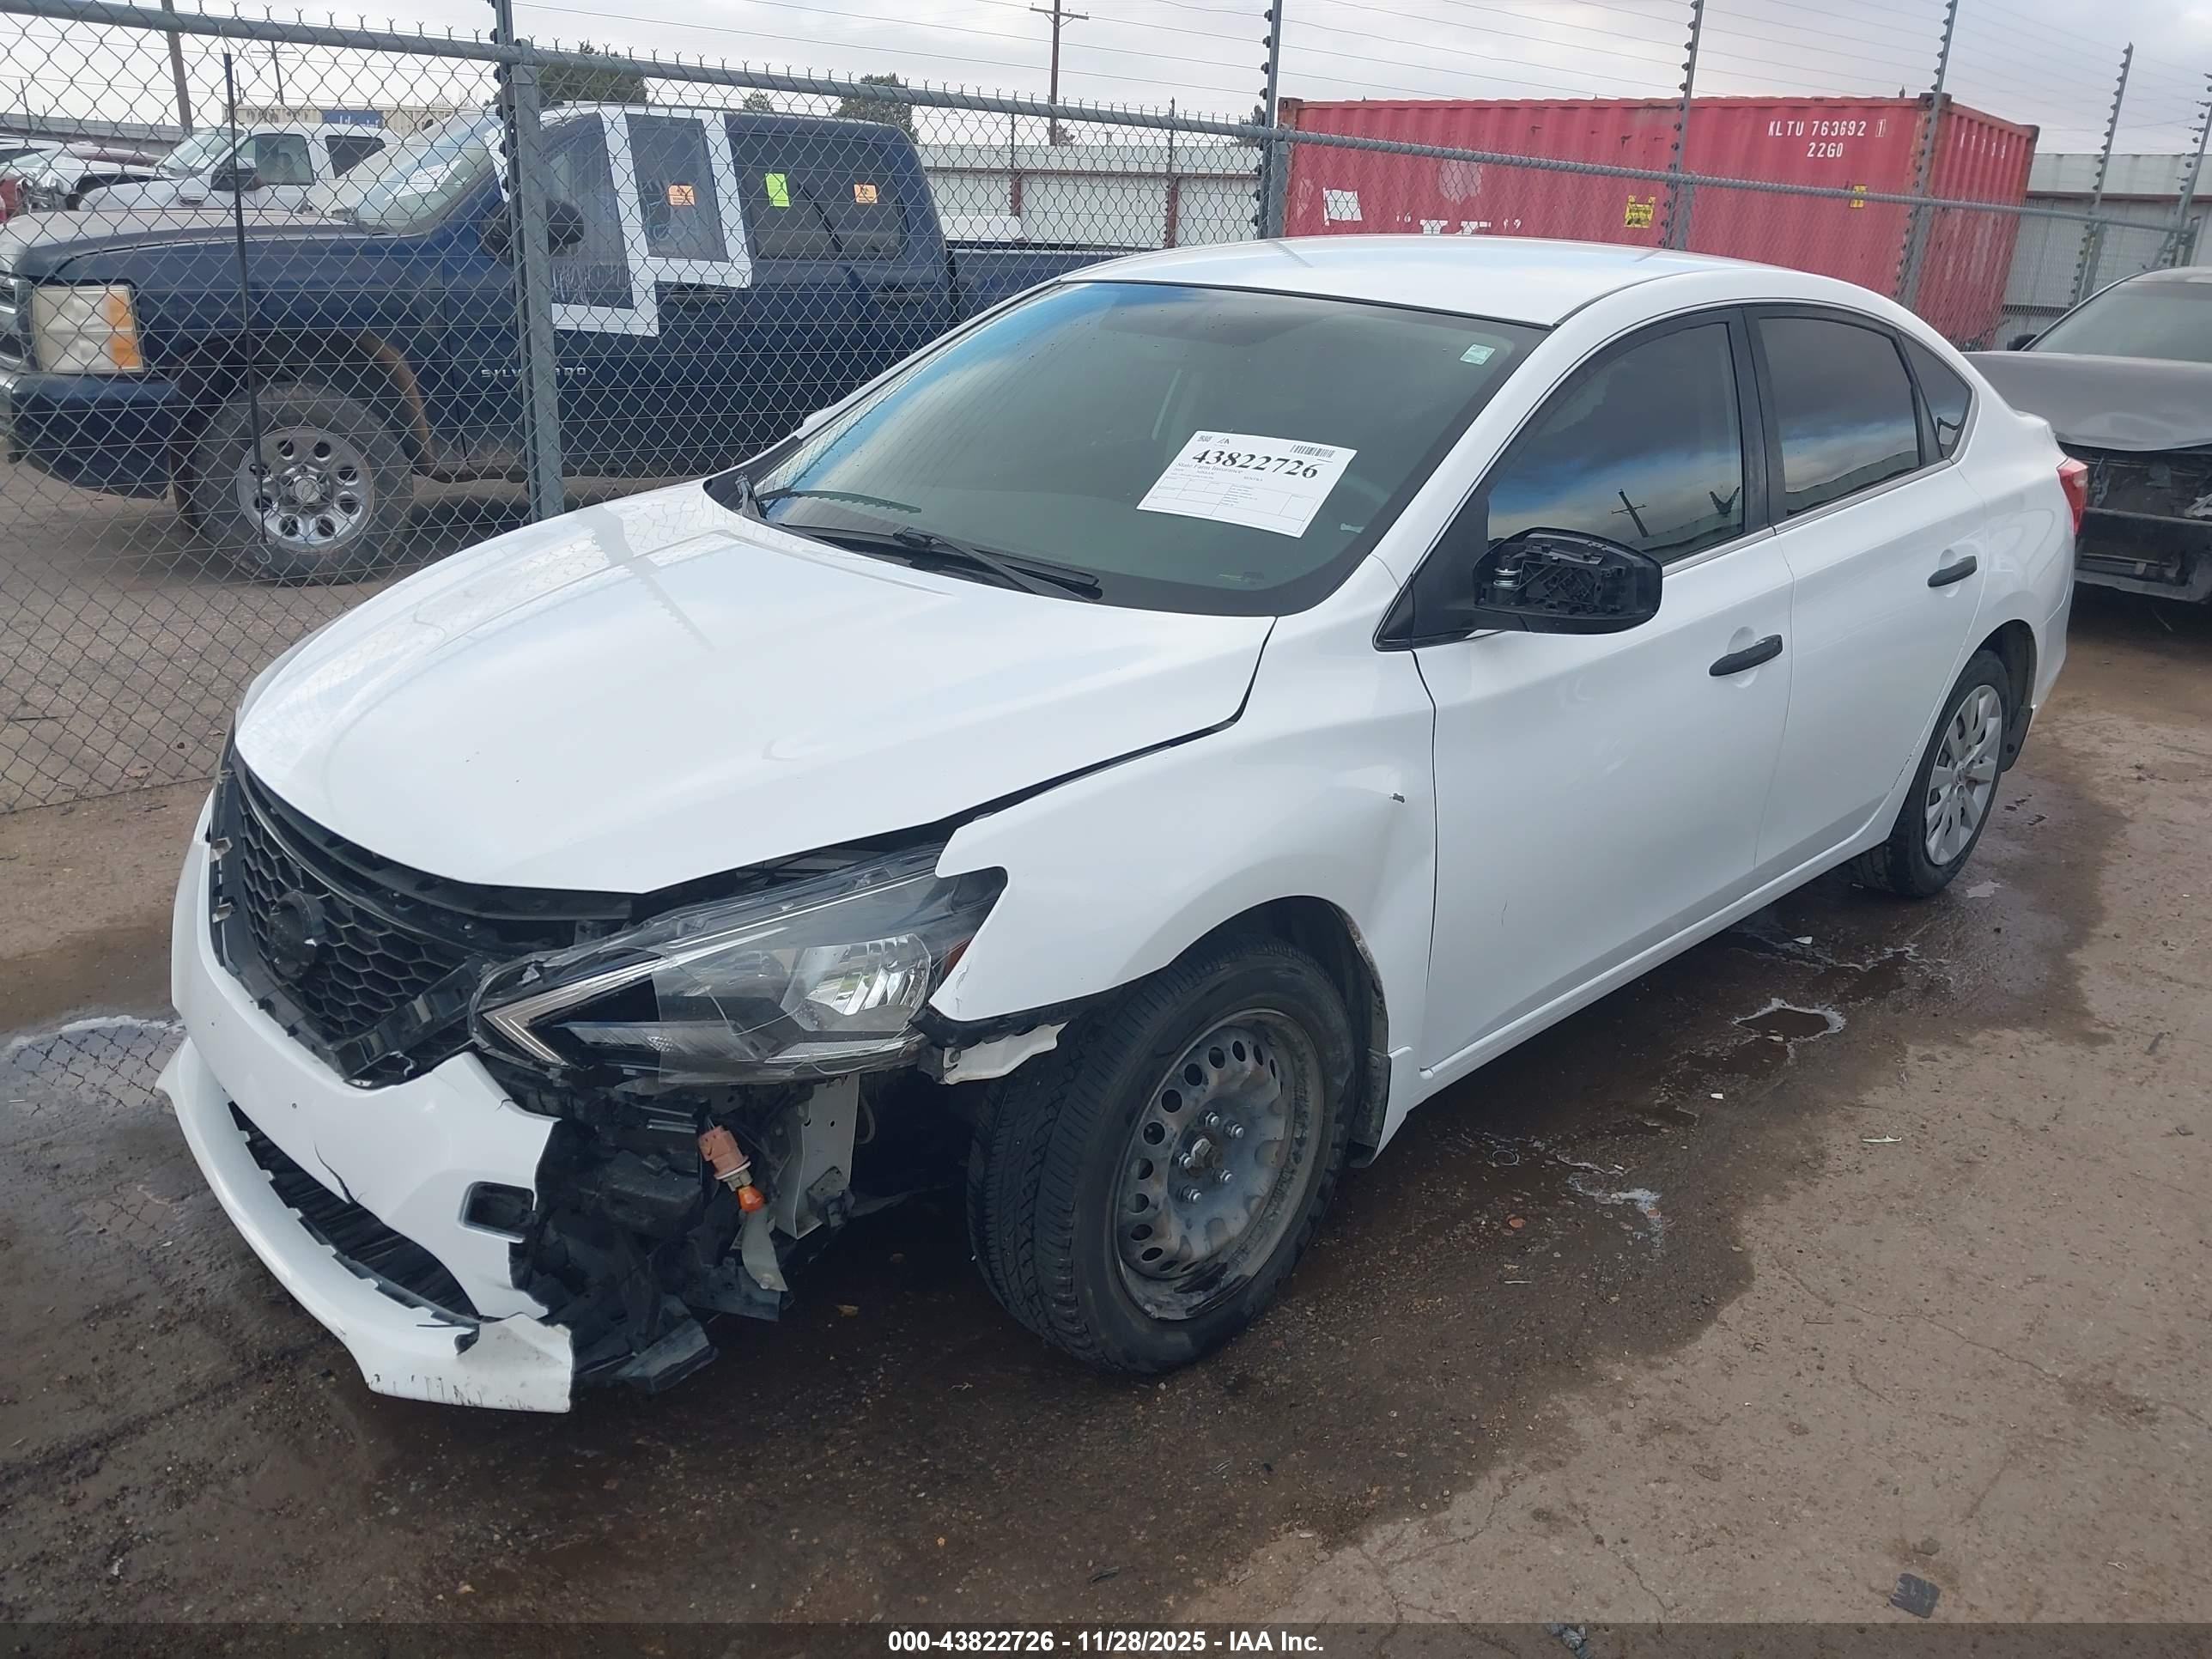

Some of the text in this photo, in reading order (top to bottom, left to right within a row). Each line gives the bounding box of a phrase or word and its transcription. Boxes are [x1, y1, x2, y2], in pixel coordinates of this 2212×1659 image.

[1768, 120, 1804, 137] KLTU
[1811, 120, 1867, 137] 763692
[481, 367, 586, 378] SILVADO
[1192, 448, 1324, 479] 43822726
